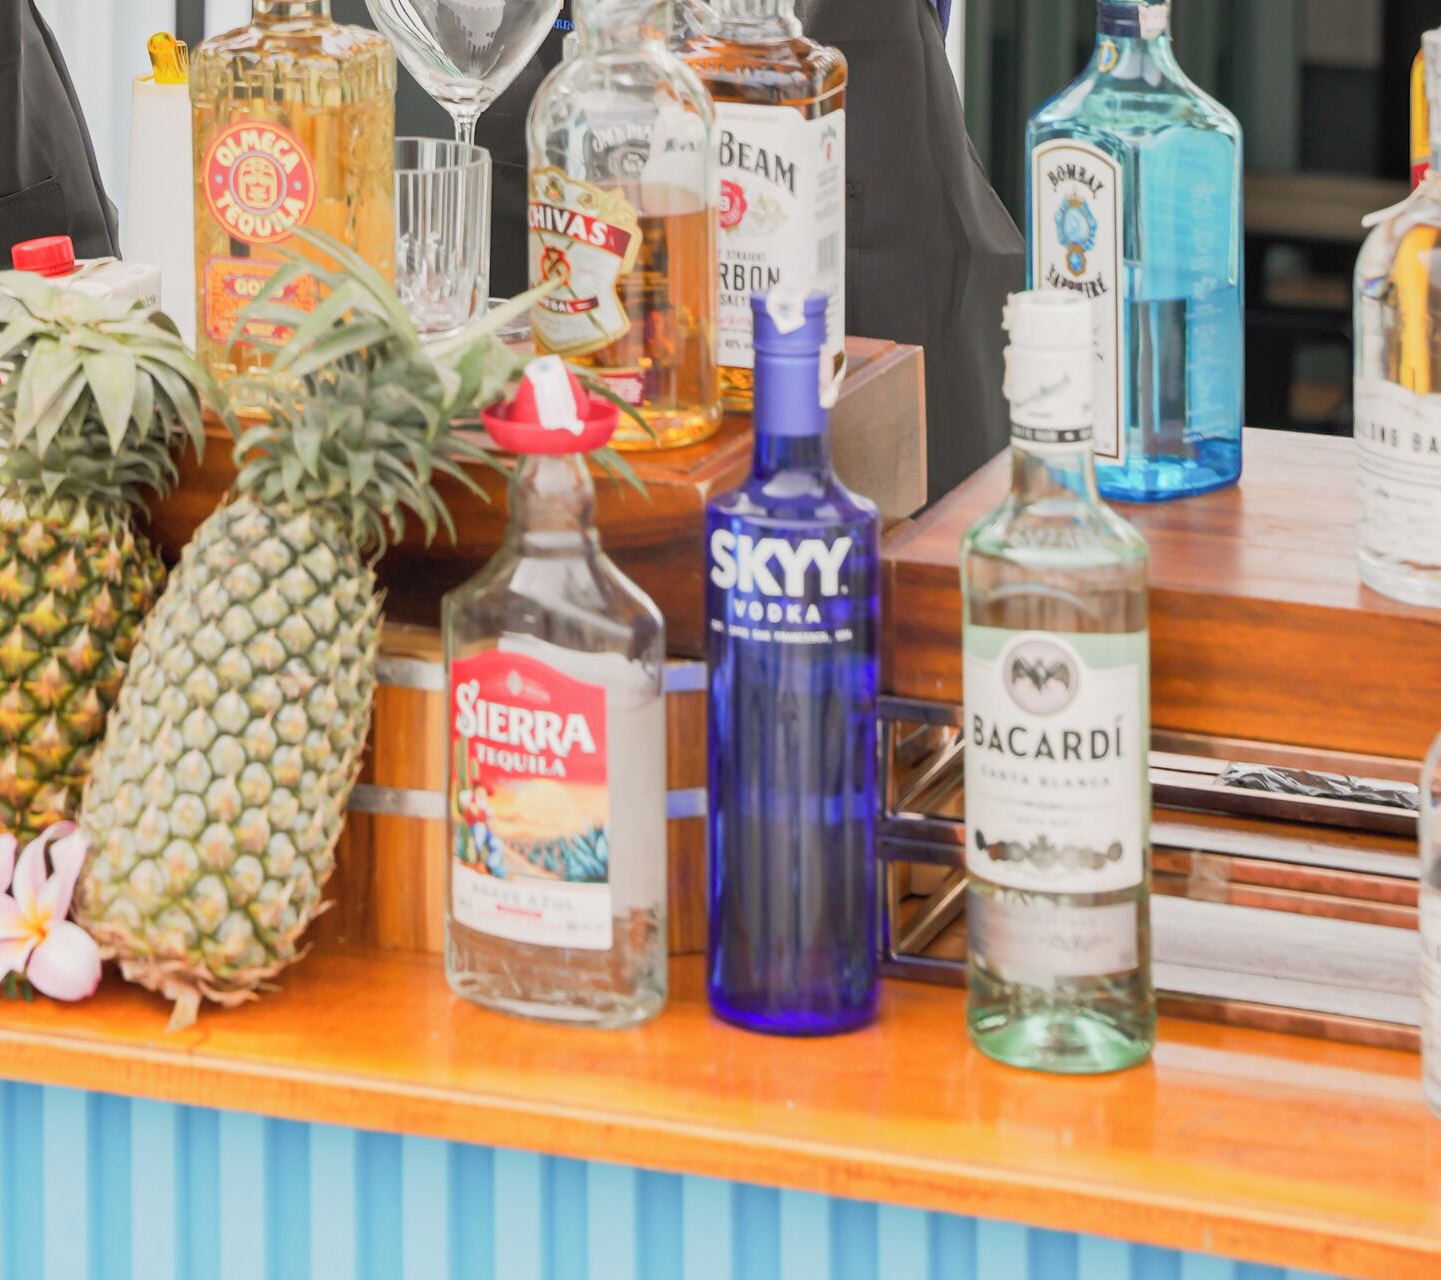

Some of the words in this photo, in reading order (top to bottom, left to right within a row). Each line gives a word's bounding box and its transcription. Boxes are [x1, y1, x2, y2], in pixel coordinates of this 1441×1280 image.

[215, 128, 301, 175] OLMECA
[719, 130, 797, 199] BEAM
[1047, 164, 1104, 199] BOMBAY
[216, 189, 306, 237] TEQUILA
[710, 528, 853, 598] SKYY
[733, 597, 822, 624] VODKA
[455, 679, 596, 757] SIERRA
[973, 714, 1124, 760] BACARDÍ
[475, 742, 567, 778] TEQUILA
